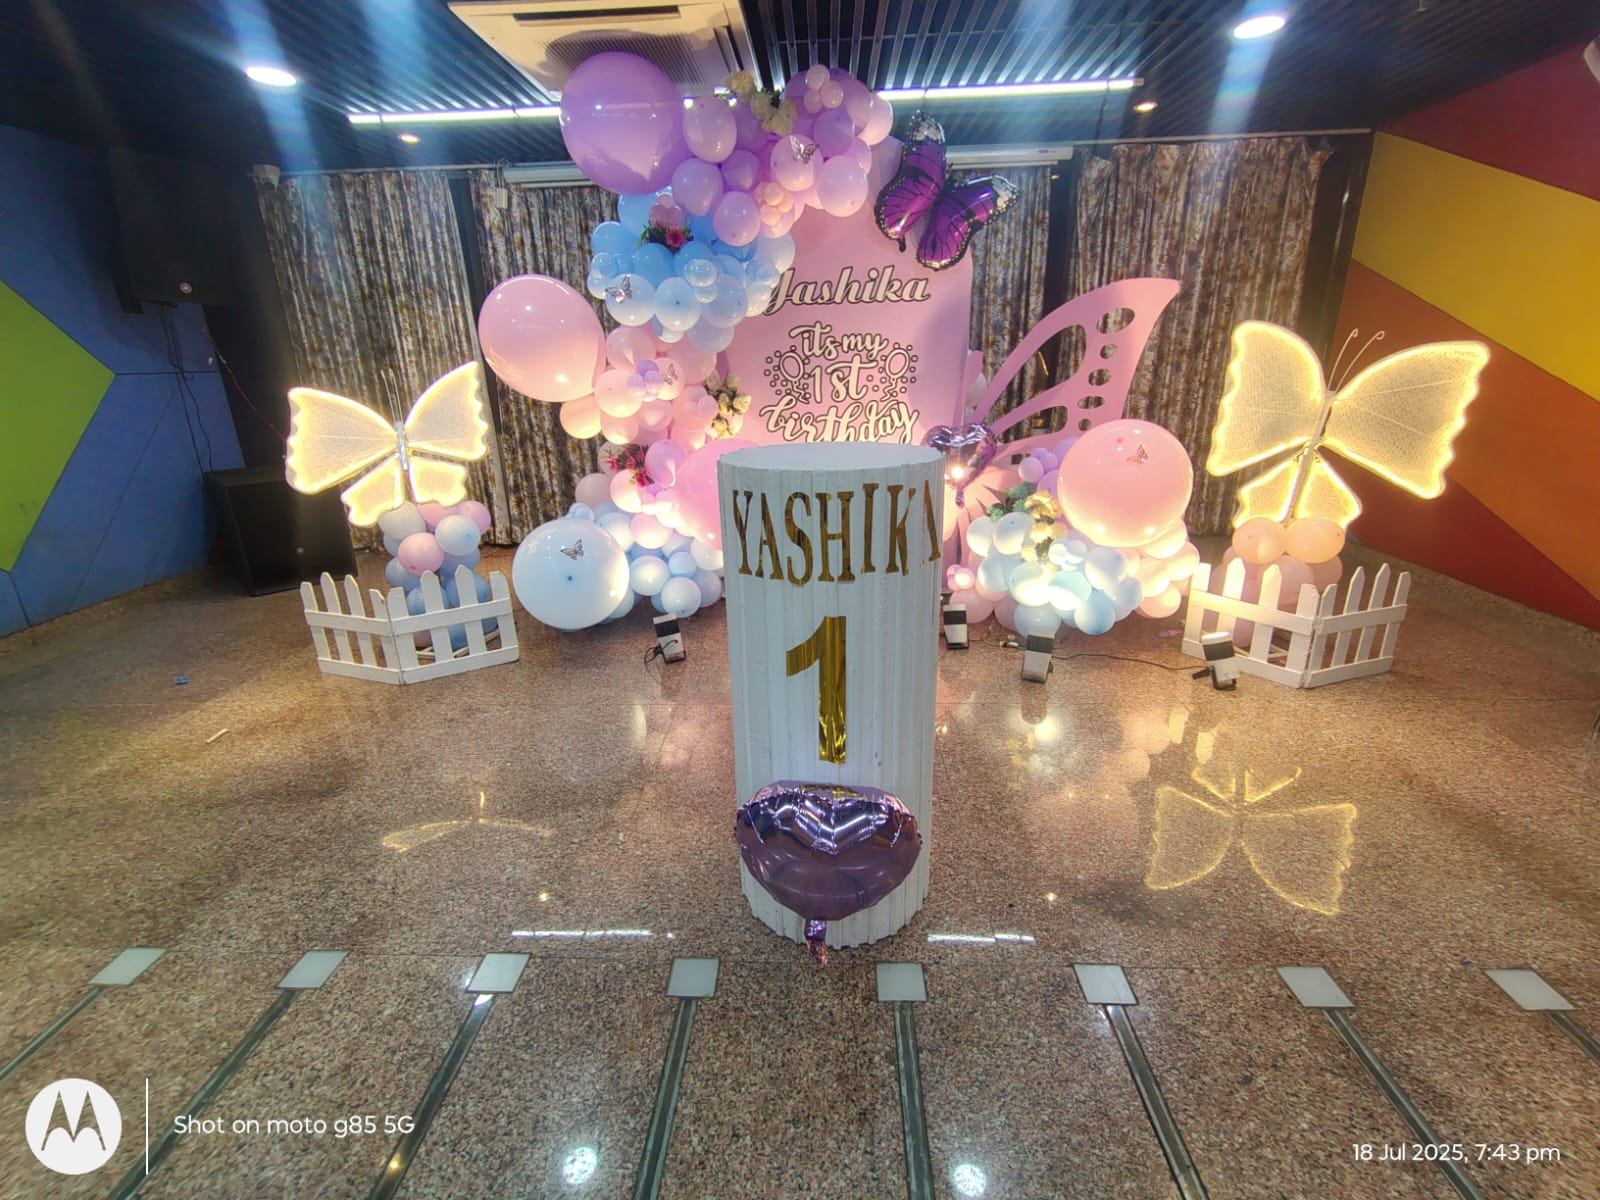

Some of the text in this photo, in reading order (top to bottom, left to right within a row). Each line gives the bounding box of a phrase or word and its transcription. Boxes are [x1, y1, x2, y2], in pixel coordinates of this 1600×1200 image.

[842, 333, 889, 359] my
[810, 354, 878, 403] 1st
[759, 395, 920, 444] birthday
[732, 480, 941, 586] YASHIKA
[786, 616, 847, 764] 1
